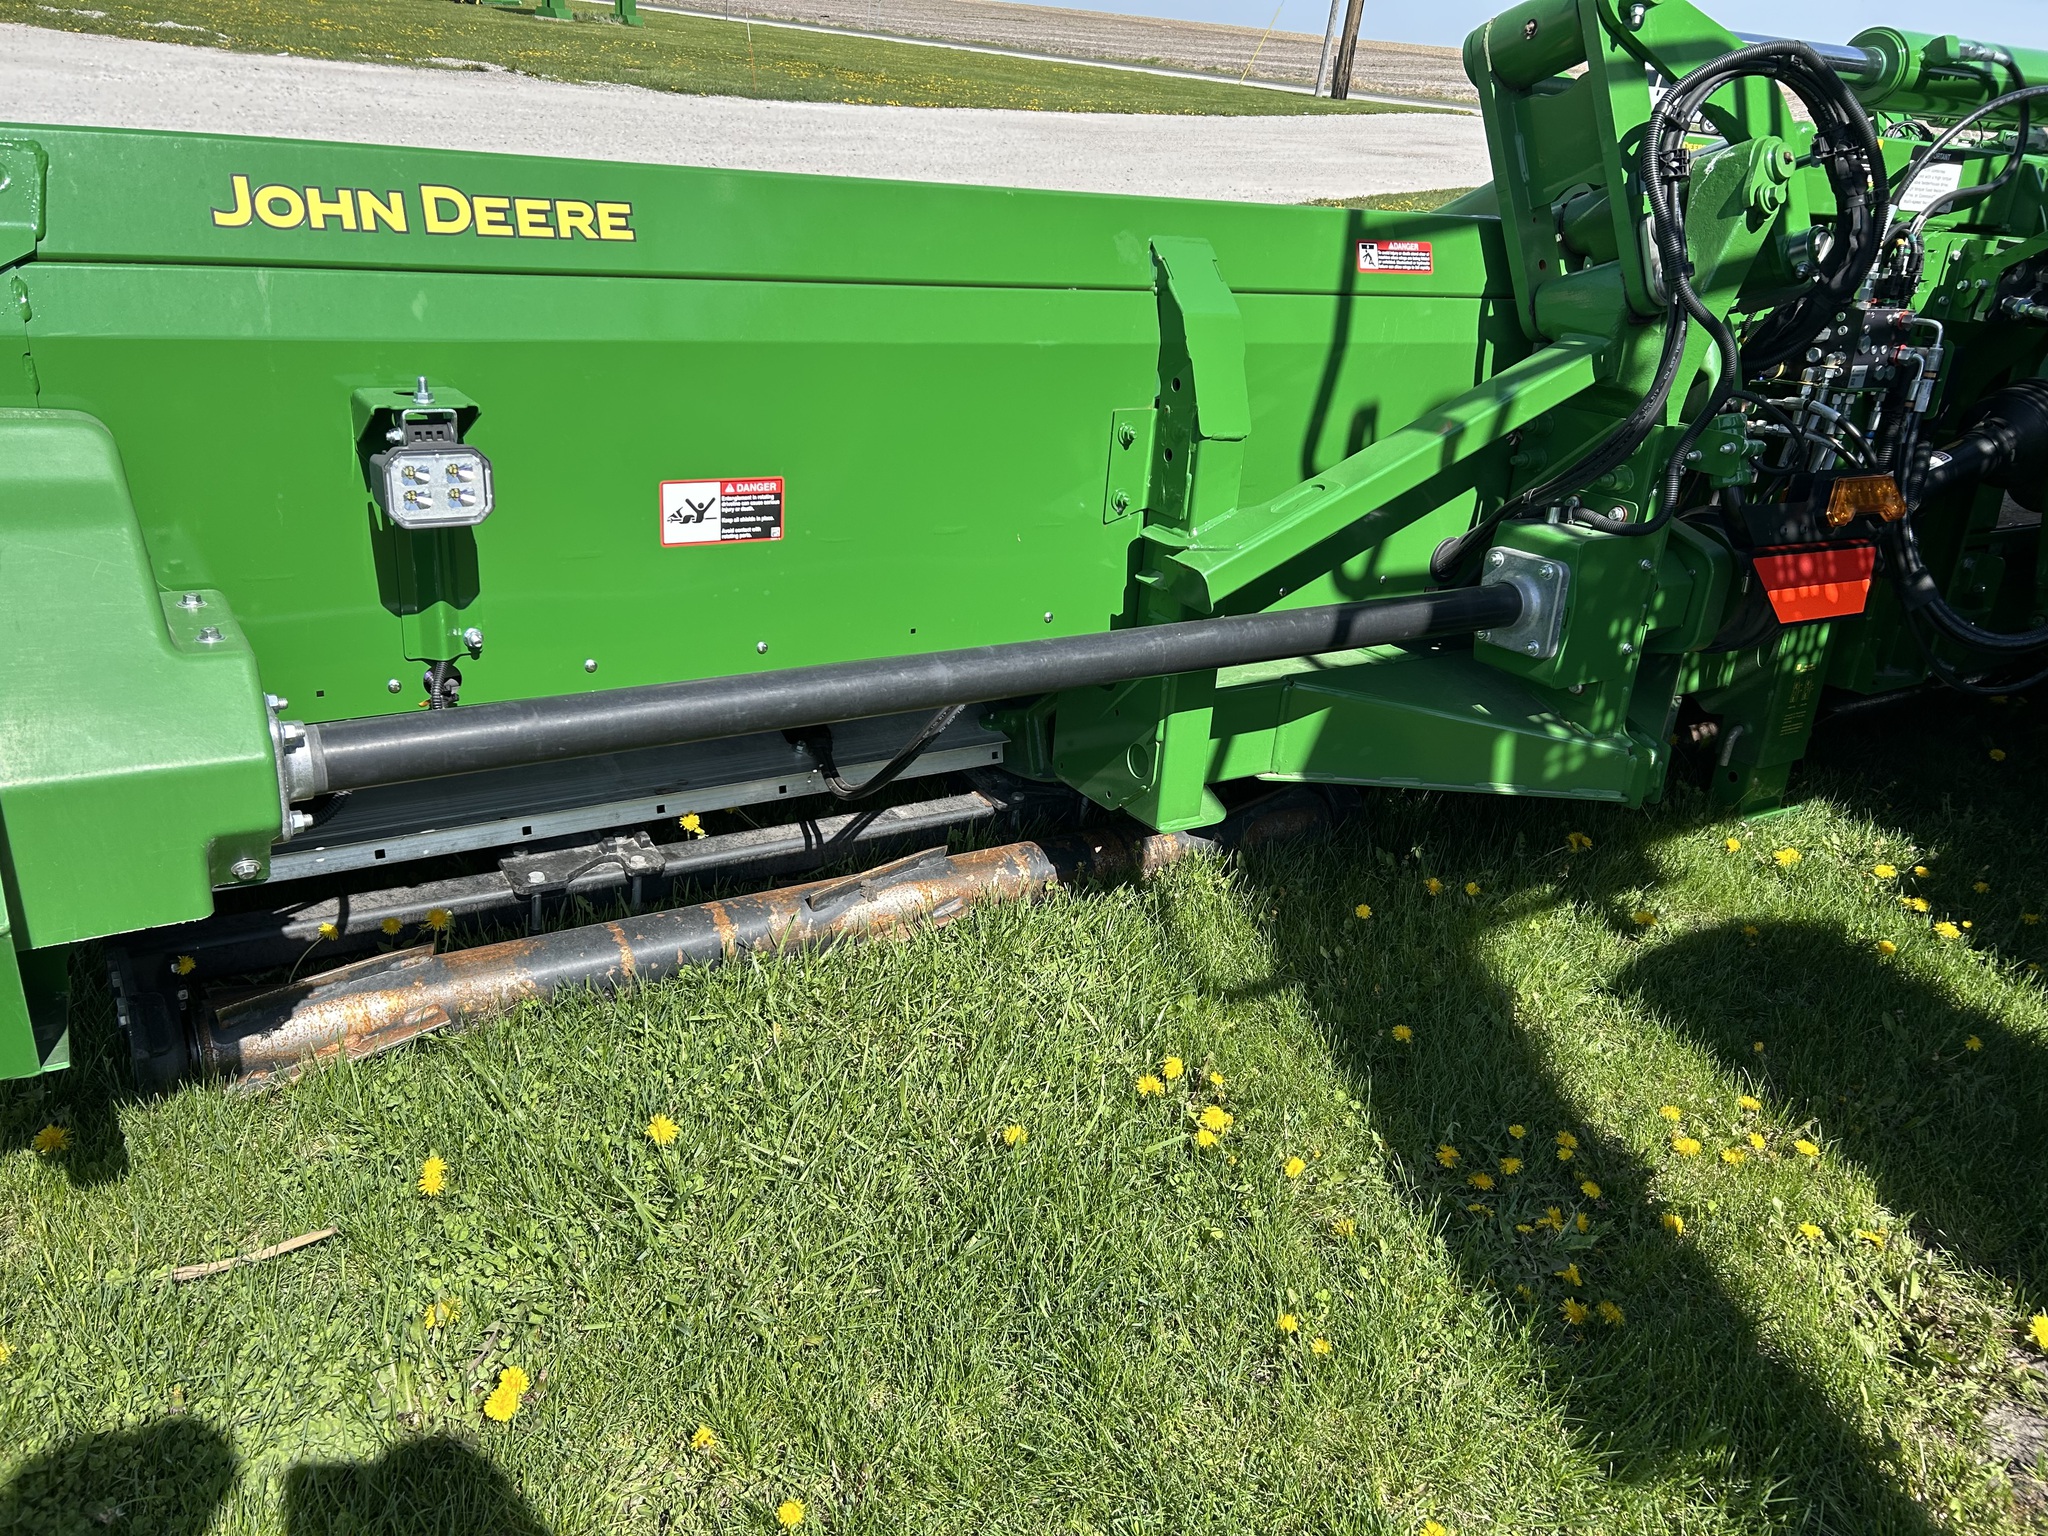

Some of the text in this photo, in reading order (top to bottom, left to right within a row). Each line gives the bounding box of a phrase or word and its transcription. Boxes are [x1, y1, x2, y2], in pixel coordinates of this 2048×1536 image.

[210, 173, 637, 242] JOHN DEERE
[1393, 243, 1419, 251] DANGER
[736, 482, 777, 493] DANGER
